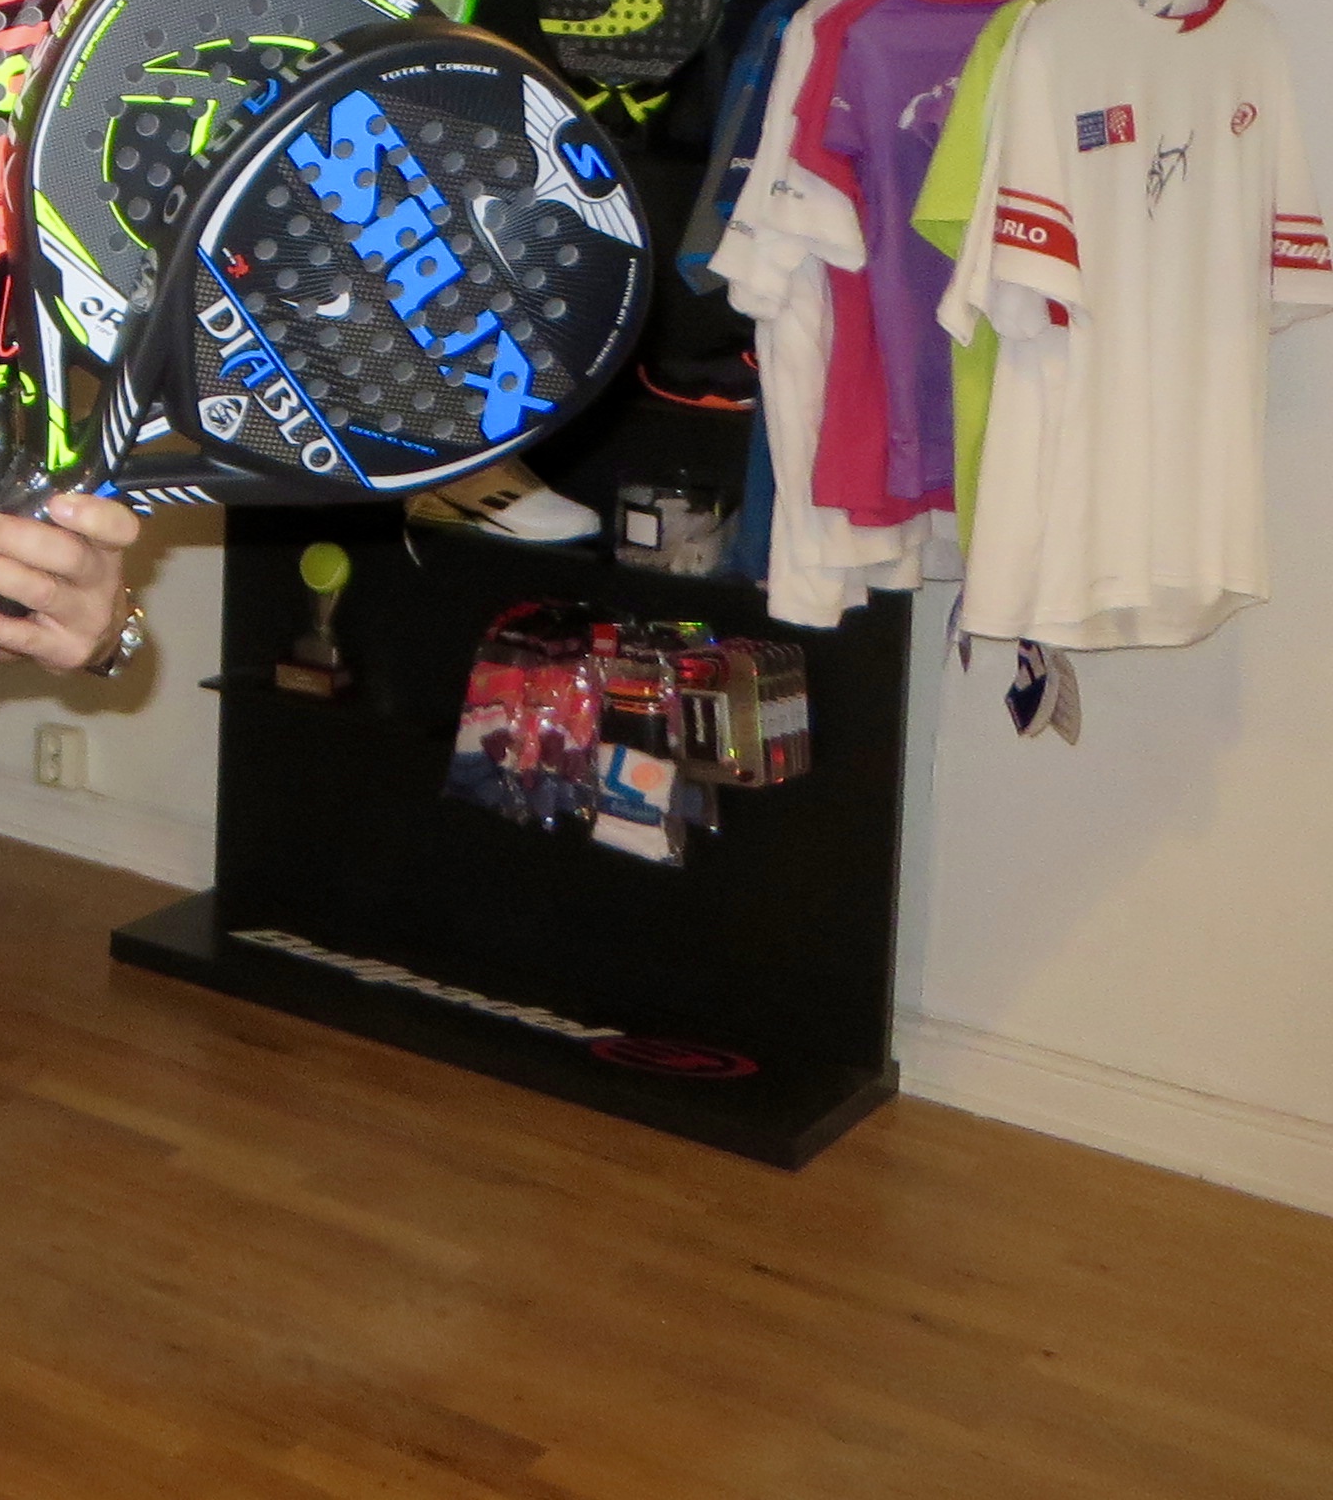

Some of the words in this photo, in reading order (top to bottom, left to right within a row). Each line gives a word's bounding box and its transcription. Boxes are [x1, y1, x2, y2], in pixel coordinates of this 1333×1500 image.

[380, 65, 429, 82] TOTAL
[434, 62, 499, 77] CARBON
[286, 89, 559, 443] SIUX
[998, 217, 1048, 245] RLO
[196, 296, 339, 475] DIABLO
